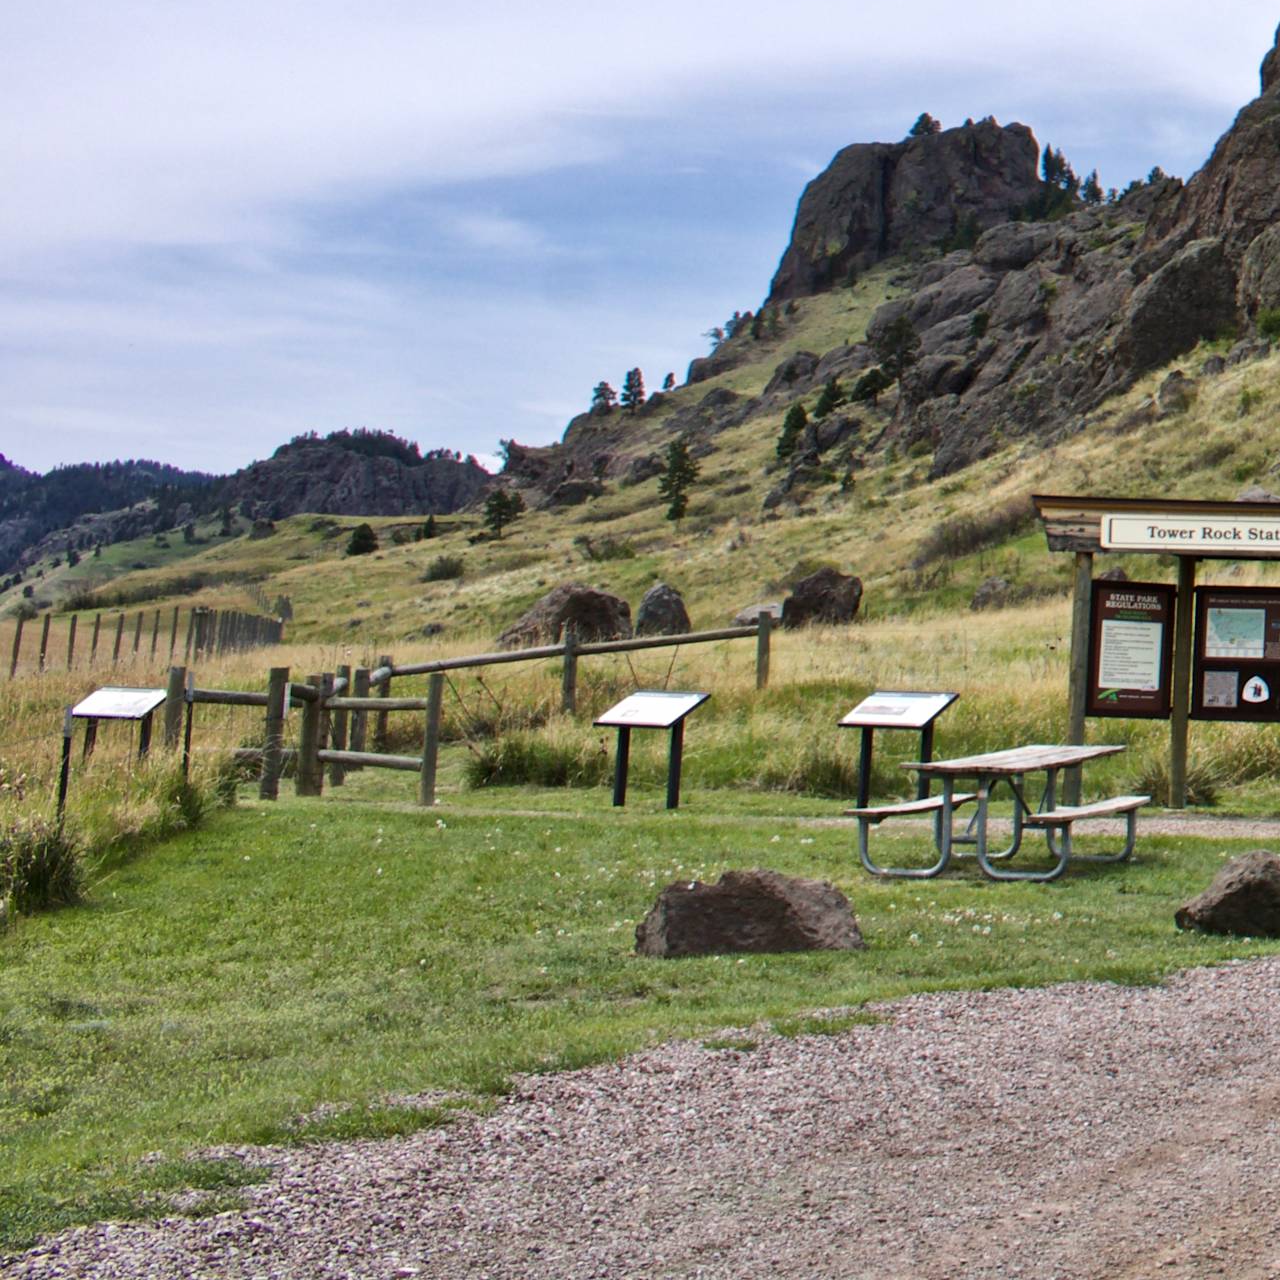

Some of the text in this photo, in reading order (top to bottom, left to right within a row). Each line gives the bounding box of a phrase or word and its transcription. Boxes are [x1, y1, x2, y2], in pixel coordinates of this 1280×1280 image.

[1147, 526, 1195, 539] Tower
[1201, 527, 1242, 540] Rock
[1110, 593, 1158, 603] STATE PARK
[1105, 600, 1162, 610] REGULATIONS
